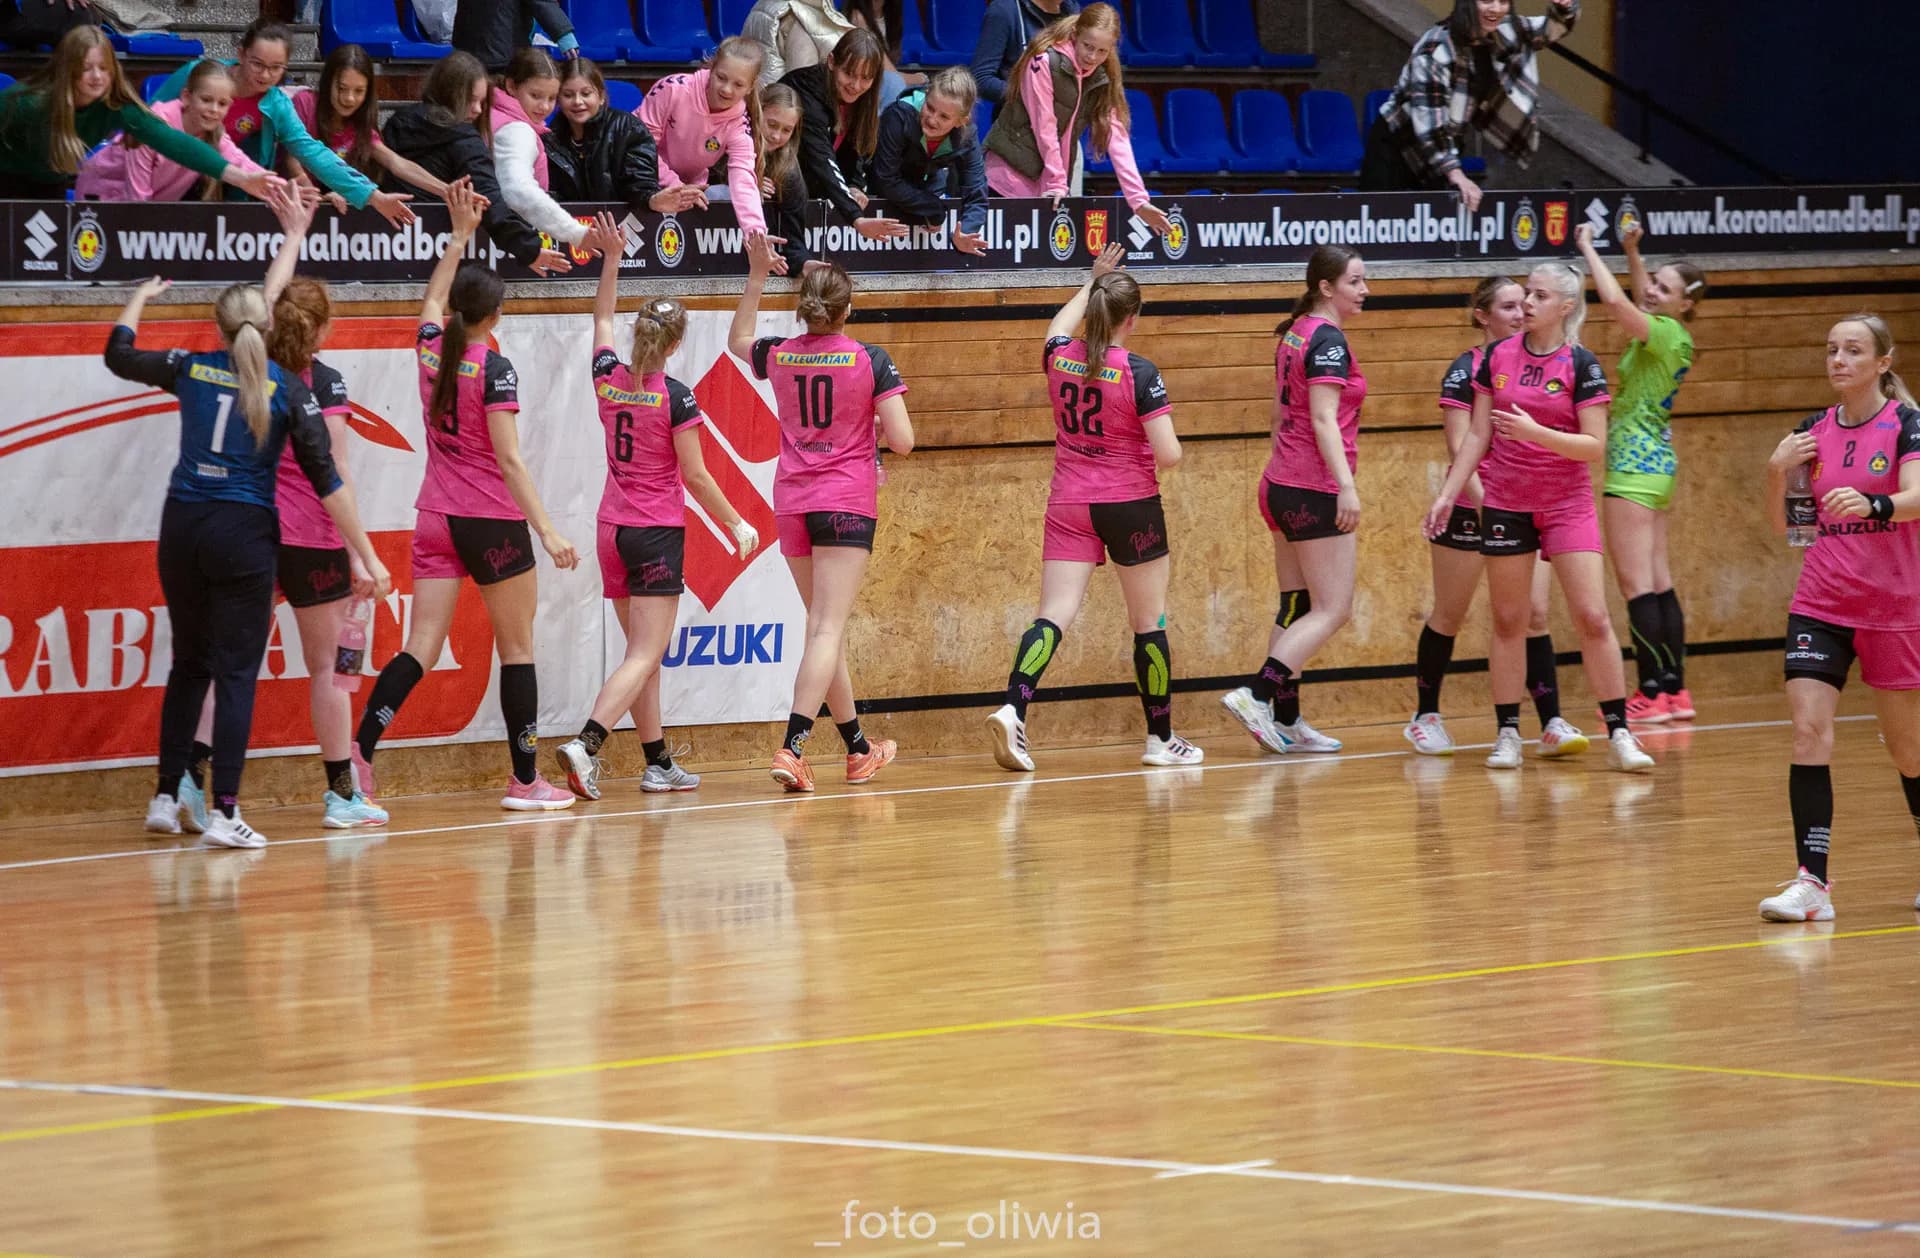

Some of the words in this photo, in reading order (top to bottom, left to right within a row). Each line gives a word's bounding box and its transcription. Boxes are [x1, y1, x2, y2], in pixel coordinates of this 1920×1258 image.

[1197, 201, 1505, 254] www.koronahandball.pl
[794, 354, 850, 365] LEWIATAN
[1519, 365, 1543, 387] 20
[211, 393, 234, 454] 1
[794, 374, 834, 430] 10
[1060, 381, 1104, 438] 32
[614, 411, 634, 463] 6
[1842, 440, 1857, 468] 2
[661, 623, 784, 668] UZUKI
